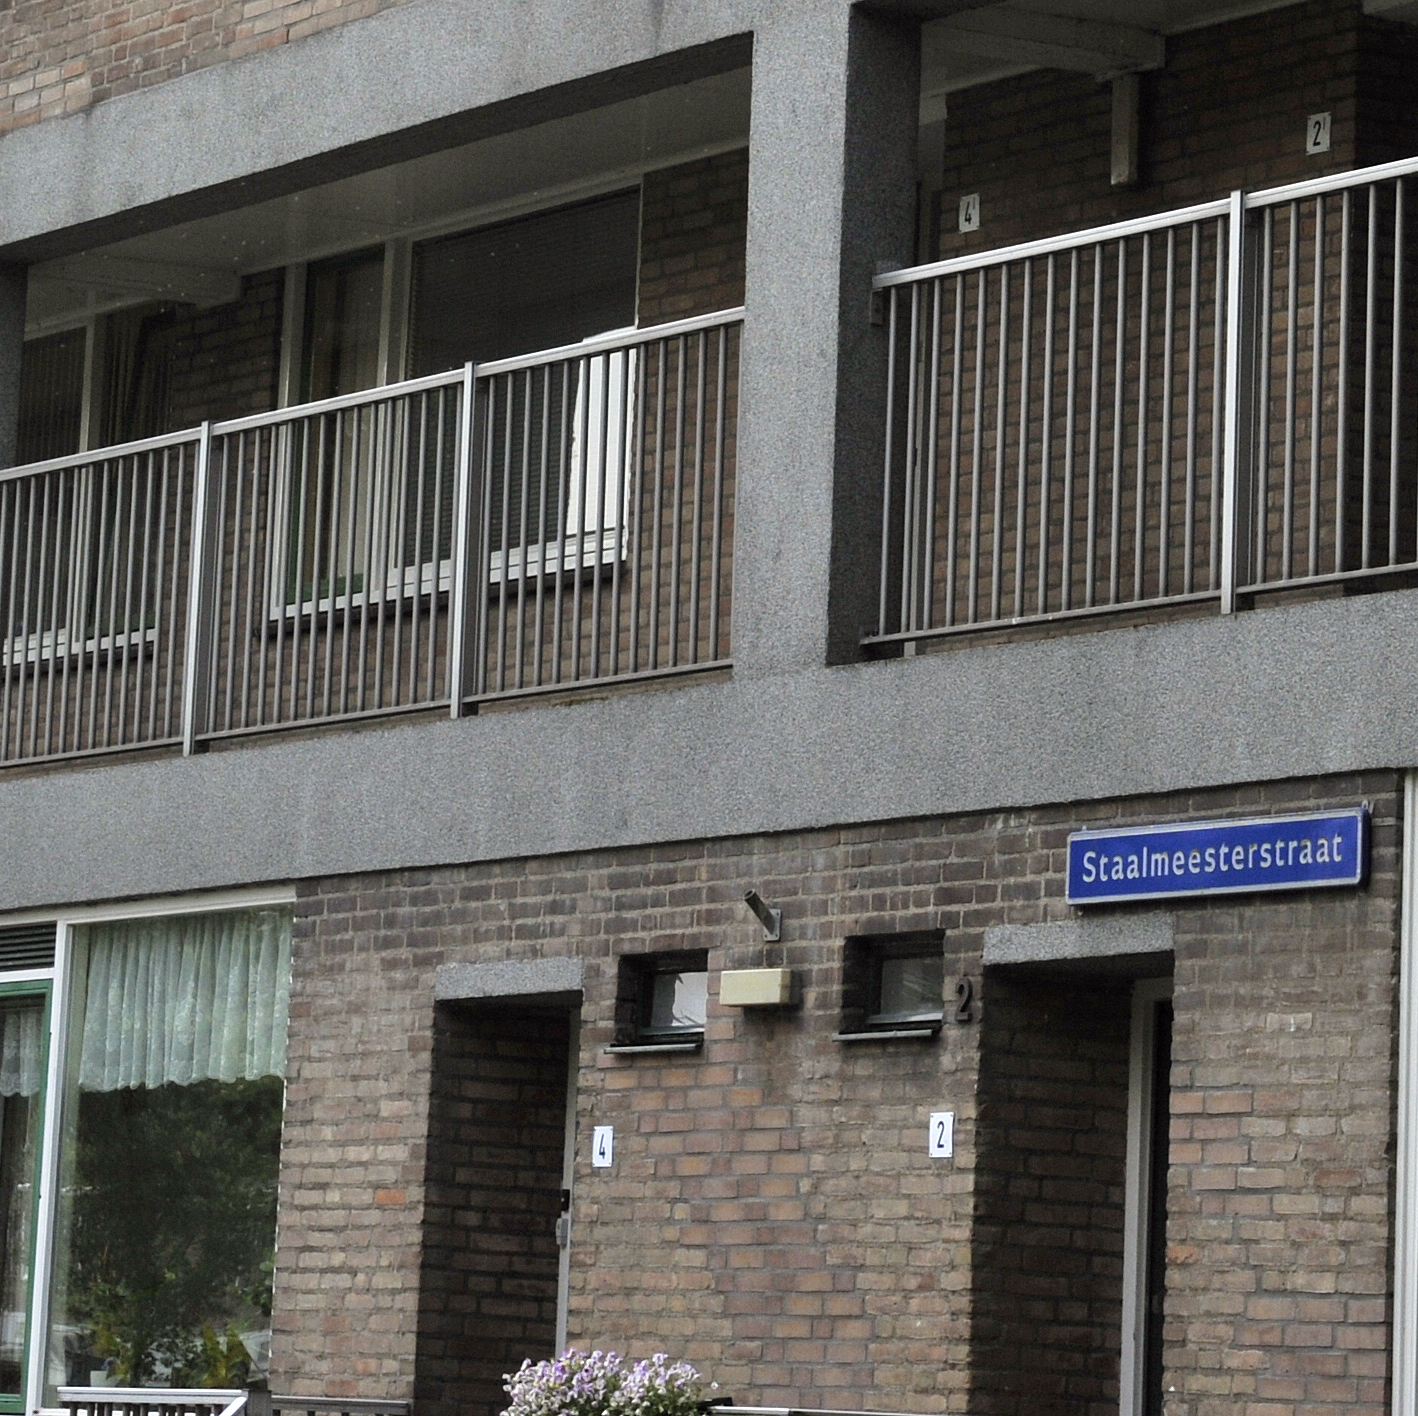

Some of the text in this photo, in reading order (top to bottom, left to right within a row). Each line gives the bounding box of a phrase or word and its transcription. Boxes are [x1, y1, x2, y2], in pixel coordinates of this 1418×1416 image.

[1082, 832, 1343, 883] Staalmeesterstraat
[955, 977, 973, 1022] 2
[598, 1133, 606, 1160] 4
[936, 1120, 945, 1149] 2
